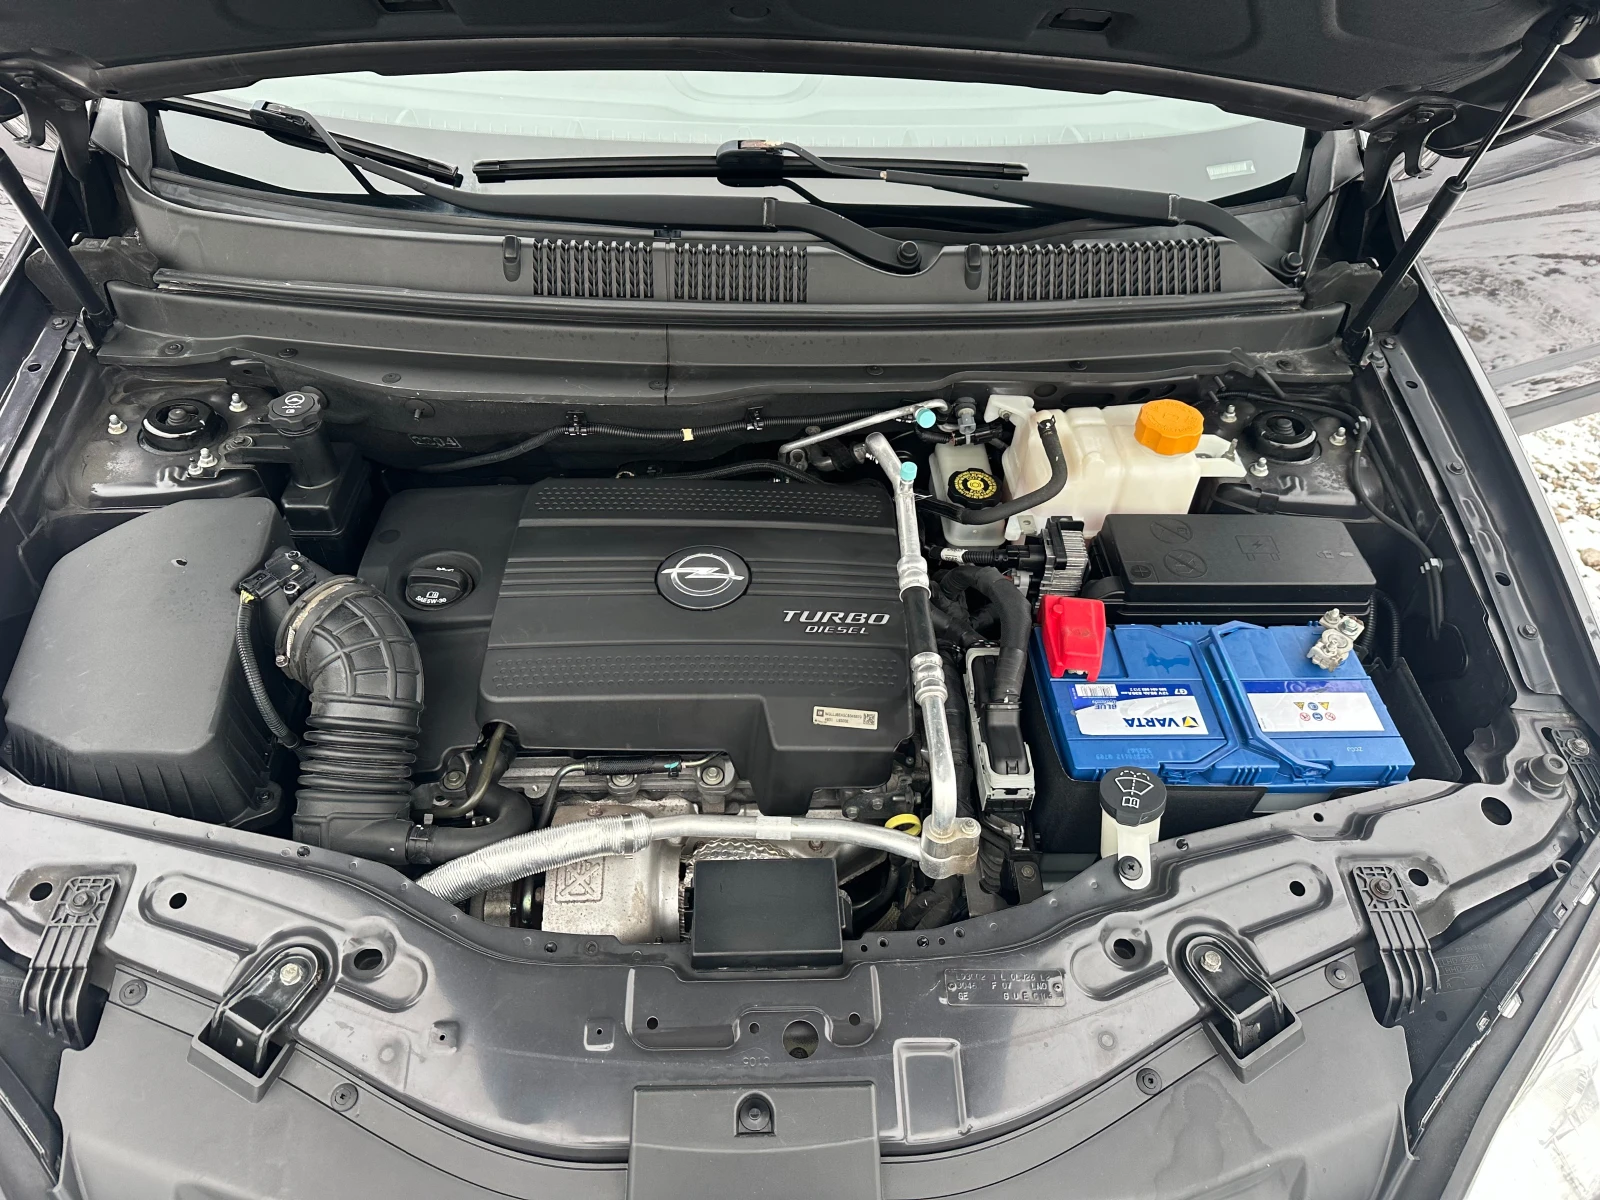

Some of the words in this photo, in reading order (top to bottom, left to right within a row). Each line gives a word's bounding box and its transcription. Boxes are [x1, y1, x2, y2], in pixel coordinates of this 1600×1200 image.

[783, 610, 890, 625] TURBO
[805, 625, 869, 634] DIESEL
[1122, 717, 1180, 728] VARTA
